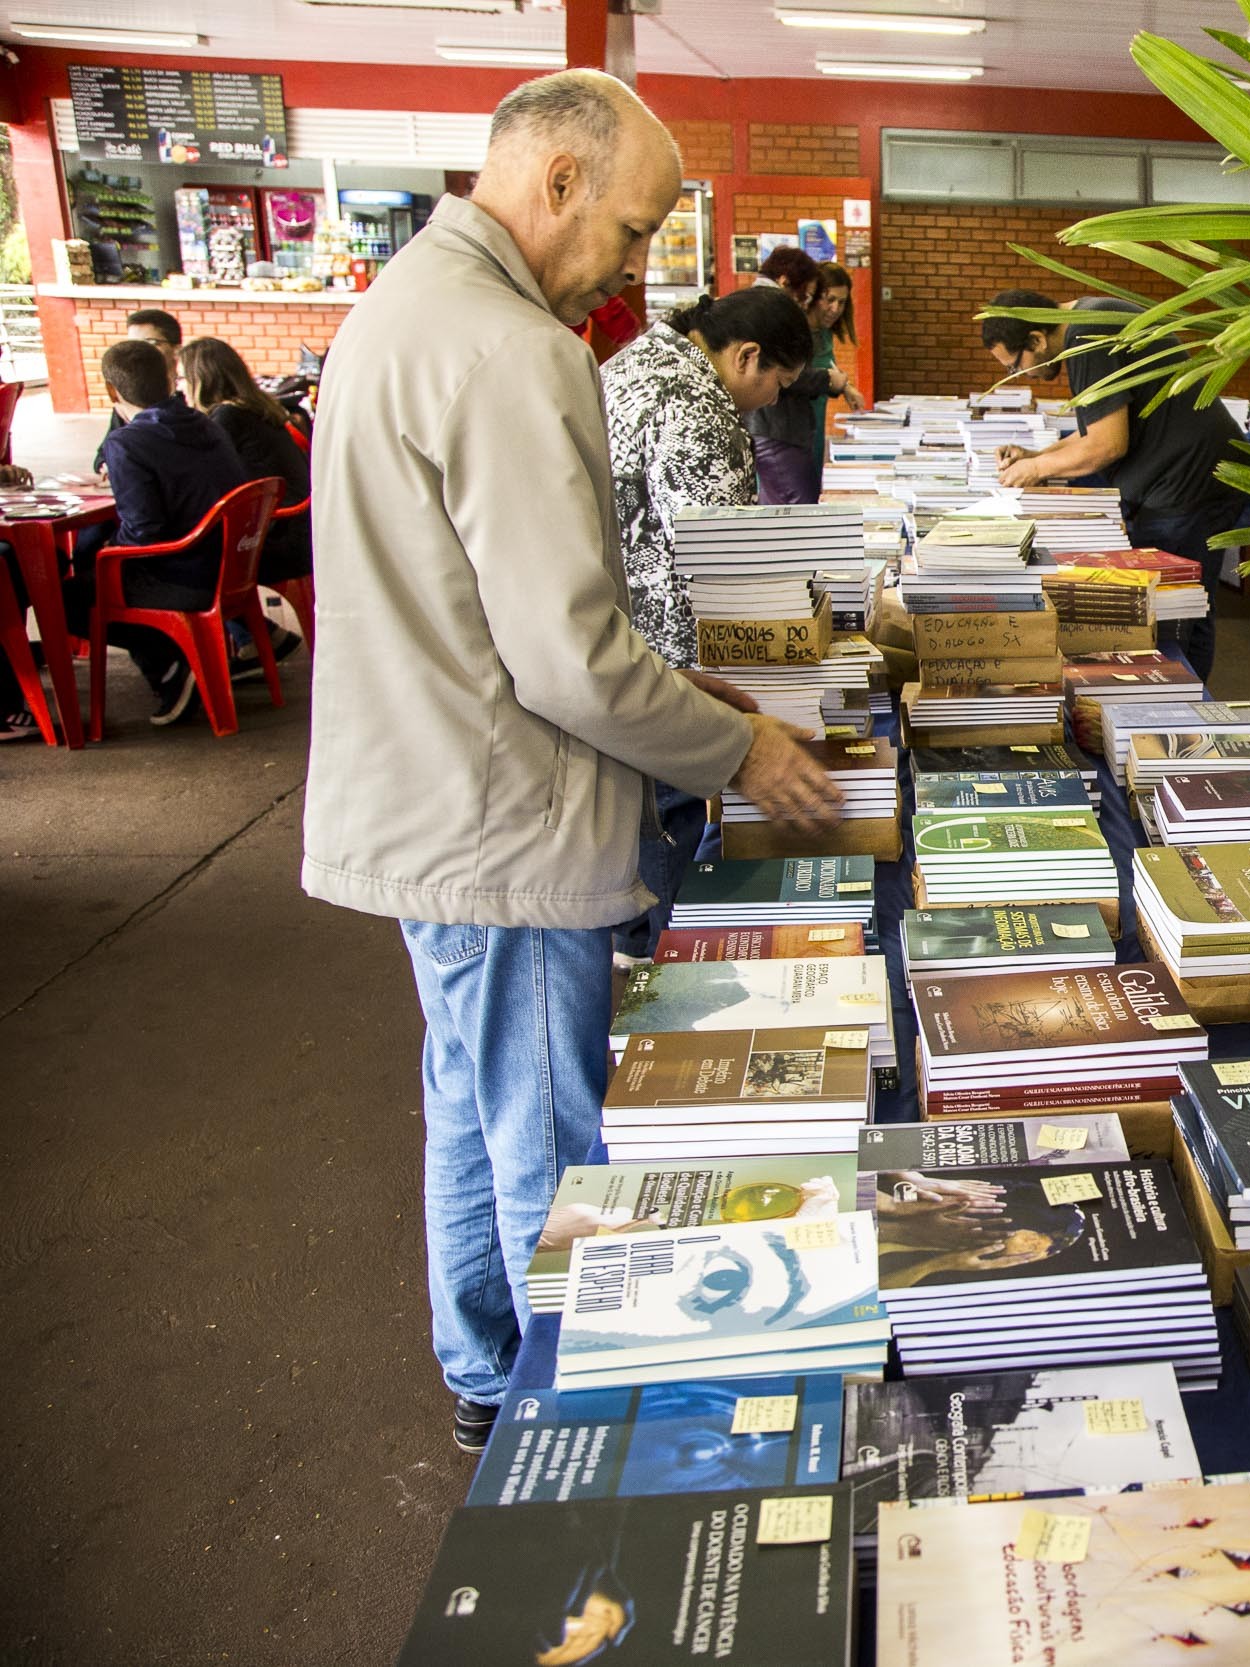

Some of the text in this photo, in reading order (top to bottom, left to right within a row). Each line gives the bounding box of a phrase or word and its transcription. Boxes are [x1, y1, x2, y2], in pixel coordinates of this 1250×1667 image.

[210, 142, 263, 154] RED BULL
[700, 621, 775, 641] MEMÓRIAS
[795, 860, 814, 892] JURÍDICO
[819, 859, 837, 899] DICIONÁRIO
[993, 910, 1015, 951] INFORMAÇÃO
[1011, 911, 1032, 948] SISTEMAS DE
[804, 964, 817, 999] GEOGRÁFICO
[816, 963, 829, 985] ESPAÇO
[1048, 976, 1070, 995] hoje
[1099, 979, 1114, 992] sua
[1073, 974, 1112, 1031] ensino de Física
[1105, 993, 1121, 1010] obra
[1113, 1010, 1128, 1021] no
[694, 1059, 714, 1094] em Debate
[714, 1058, 735, 1084] Império
[920, 1127, 938, 1167] (1542-1591)
[938, 1127, 956, 1166] DA CRUZ
[955, 1125, 979, 1165] SÃO JOÃO
[656, 1173, 675, 1204] Biodiesel
[669, 1172, 691, 1227] de Qualidade do
[691, 1172, 710, 1204] Produção
[1139, 1169, 1159, 1200] História
[1150, 1206, 1168, 1231] cultura
[677, 1235, 721, 1244] O
[629, 1240, 674, 1278] OLHAR
[574, 1243, 627, 1314] NO ESPELHO
[949, 1392, 969, 1436] Geografia
[691, 1510, 727, 1654] DO DOENTE DE CÂNCER
[714, 1503, 749, 1658] O CUIDADO NA VIVÊNCIA
[1034, 1560, 1059, 1641] ioculturais
[1060, 1563, 1087, 1642] bordagens
[1007, 1619, 1031, 1664] Física
